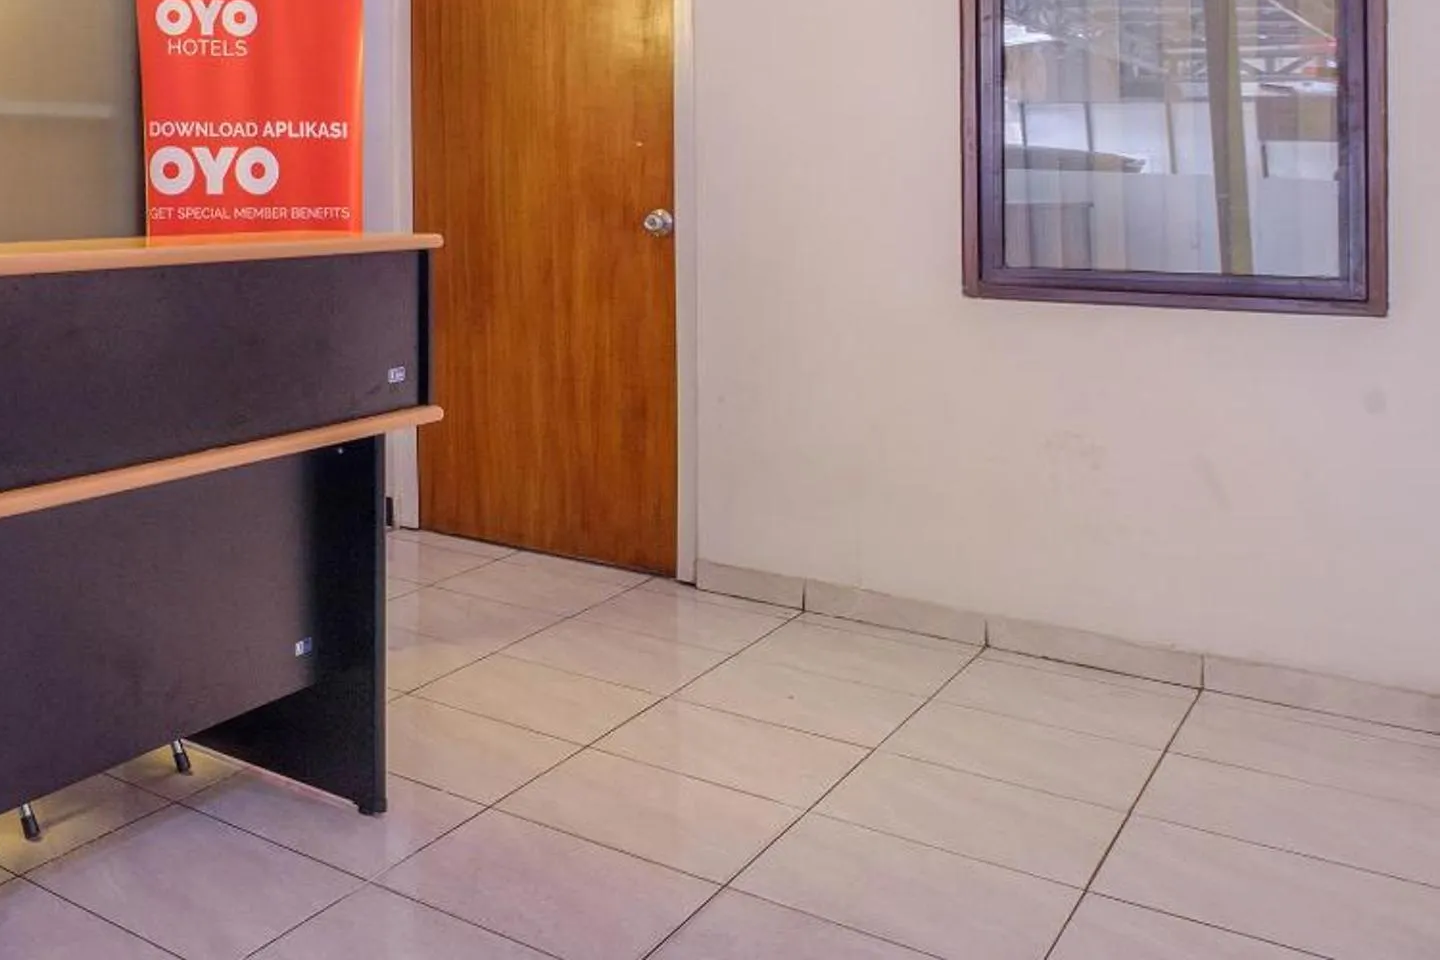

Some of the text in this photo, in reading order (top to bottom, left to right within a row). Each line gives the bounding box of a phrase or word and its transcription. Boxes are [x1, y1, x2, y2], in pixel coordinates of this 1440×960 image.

[167, 39, 248, 56] HOTELS
[149, 121, 348, 139] DOWNLOAD APLIKASI
[149, 145, 280, 195] OYO
[150, 206, 350, 220] GET SPECIAL MEMBER BENEFITS
